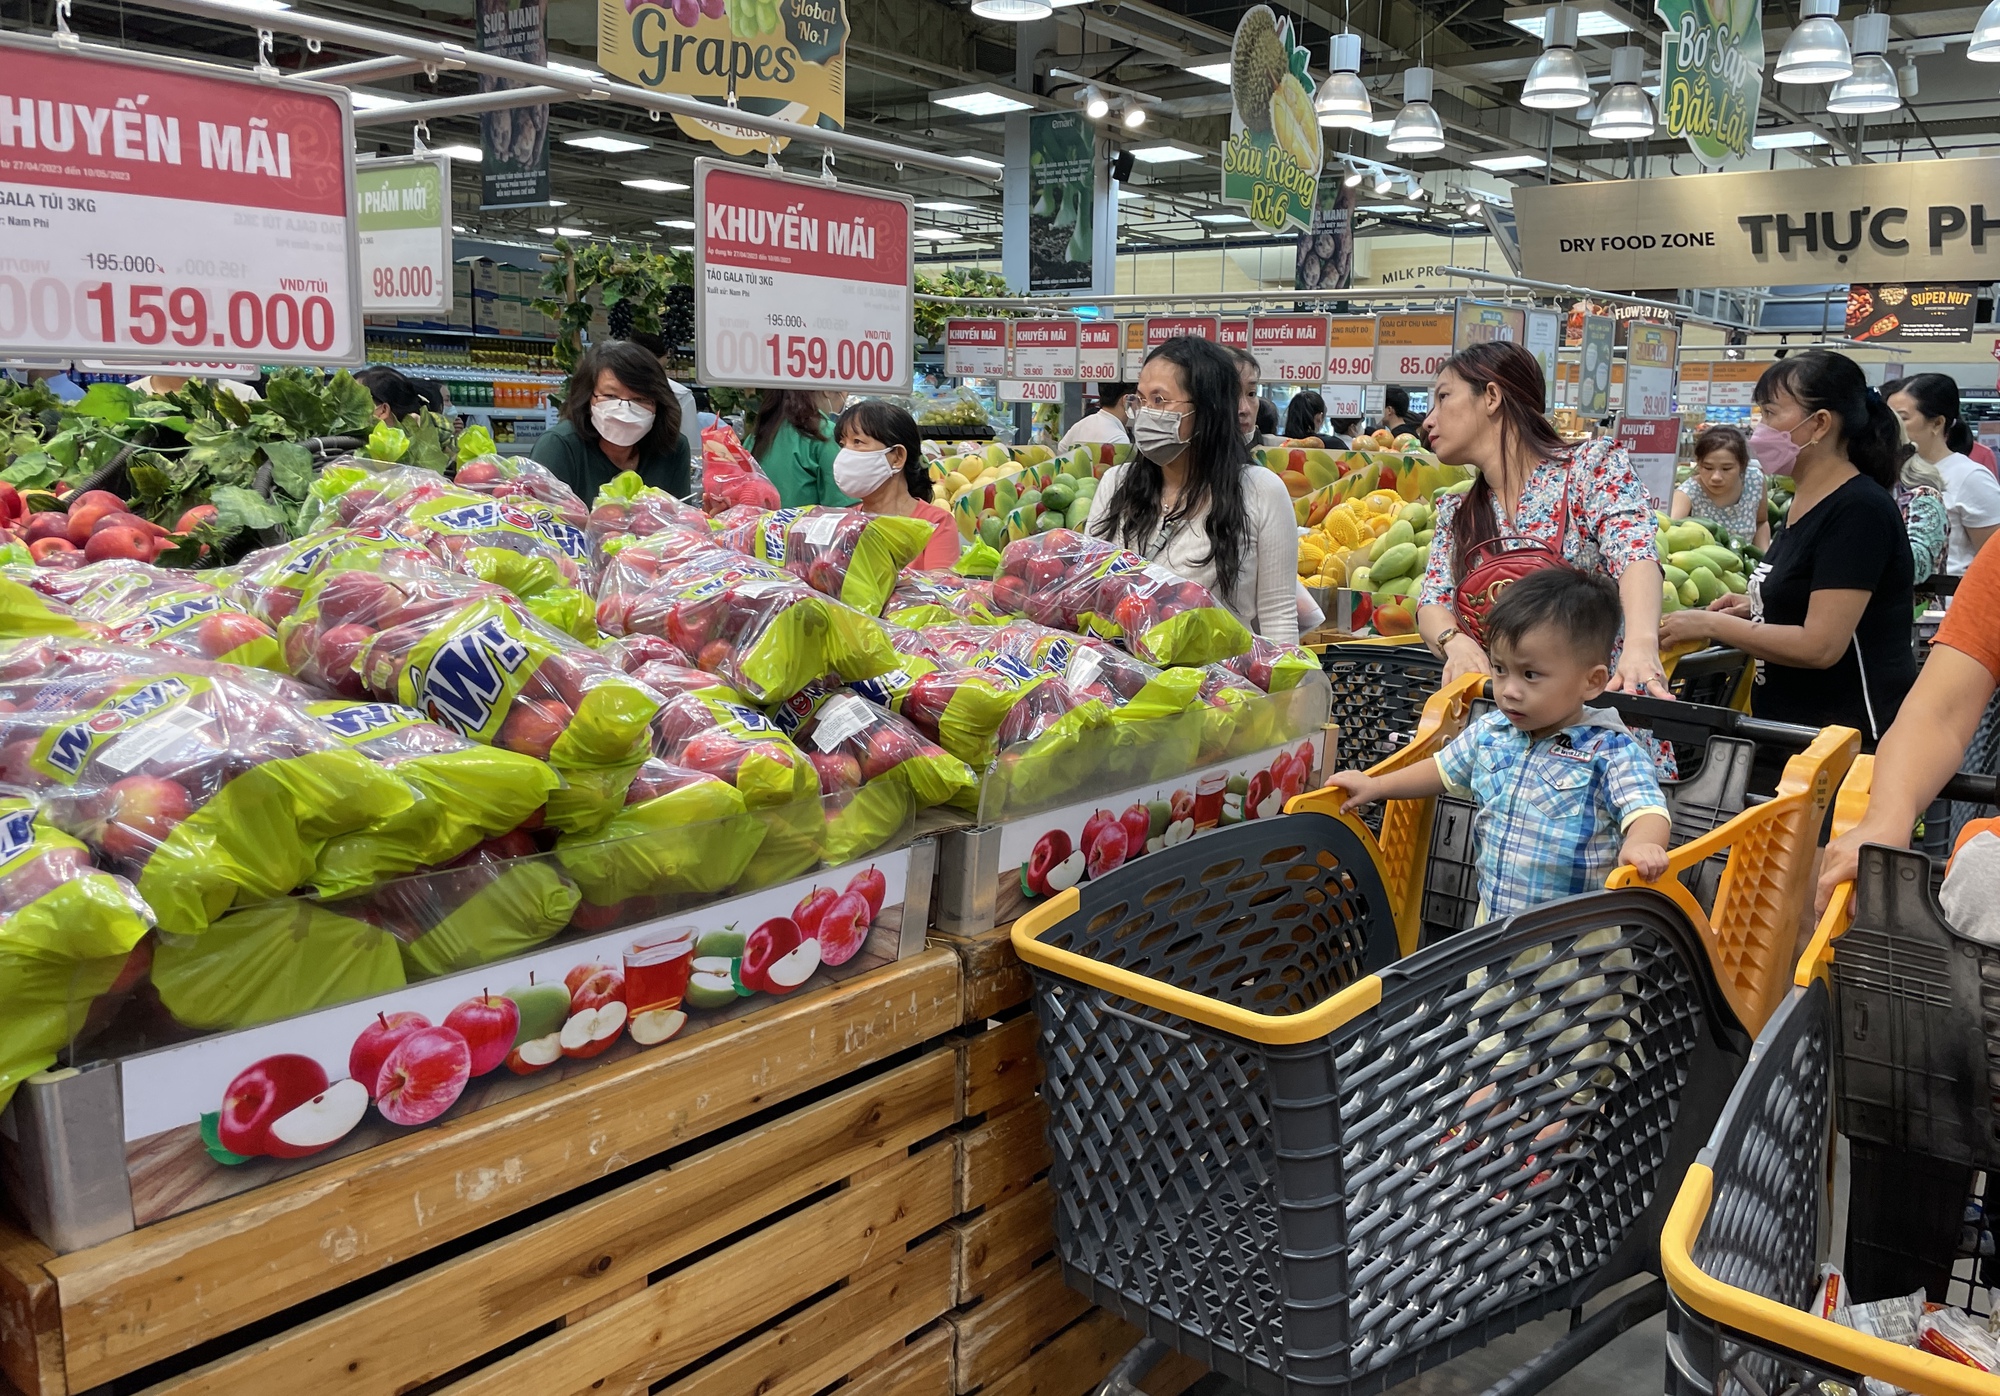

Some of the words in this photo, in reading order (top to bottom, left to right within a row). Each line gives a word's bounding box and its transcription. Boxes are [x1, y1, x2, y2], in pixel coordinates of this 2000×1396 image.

[798, 21, 829, 46] No.1
[632, 8, 797, 95] Grapes
[1678, 14, 1711, 68] Bơ
[1711, 25, 1748, 97] Sáp
[1668, 75, 1714, 135] Đắk
[1716, 93, 1748, 157] Lắk
[198, 116, 292, 179] MÃI
[1224, 129, 1262, 177] Sầu
[1265, 145, 1317, 208] Riêng
[67, 197, 97, 213] 3KG
[8, 216, 31, 227] Nam
[707, 202, 819, 252] KHUYẾN
[827, 217, 875, 260] MÃI
[1738, 206, 1909, 264] THỰC
[1559, 237, 1596, 253] DRY
[1600, 234, 1657, 251] FOOD
[1661, 231, 1716, 248] ZONE
[86, 252, 156, 273] 195.000
[373, 265, 433, 297] 98.000
[724, 271, 744, 283] GALA
[759, 275, 774, 286] 3KG
[1382, 268, 1415, 285] MILK
[1911, 291, 1947, 306] SUPER
[1947, 291, 1973, 306] NUT
[87, 282, 335, 351] 159.000
[767, 314, 802, 328] 195.000
[1615, 306, 1651, 320] FLOWER
[949, 326, 979, 340] KHUYẾN
[1017, 327, 1048, 341] KHUYẾN
[1255, 323, 1294, 339] KHUYẾN
[1297, 325, 1316, 339] MÃI
[767, 333, 894, 382] 159.000
[1328, 357, 1374, 375] 49.90
[1080, 366, 1115, 378] 39.900
[1279, 365, 1321, 380] 15.900
[1022, 383, 1057, 400] 24.900
[1336, 402, 1358, 415] 79.900
[1621, 421, 1655, 435] KHUYẾN
